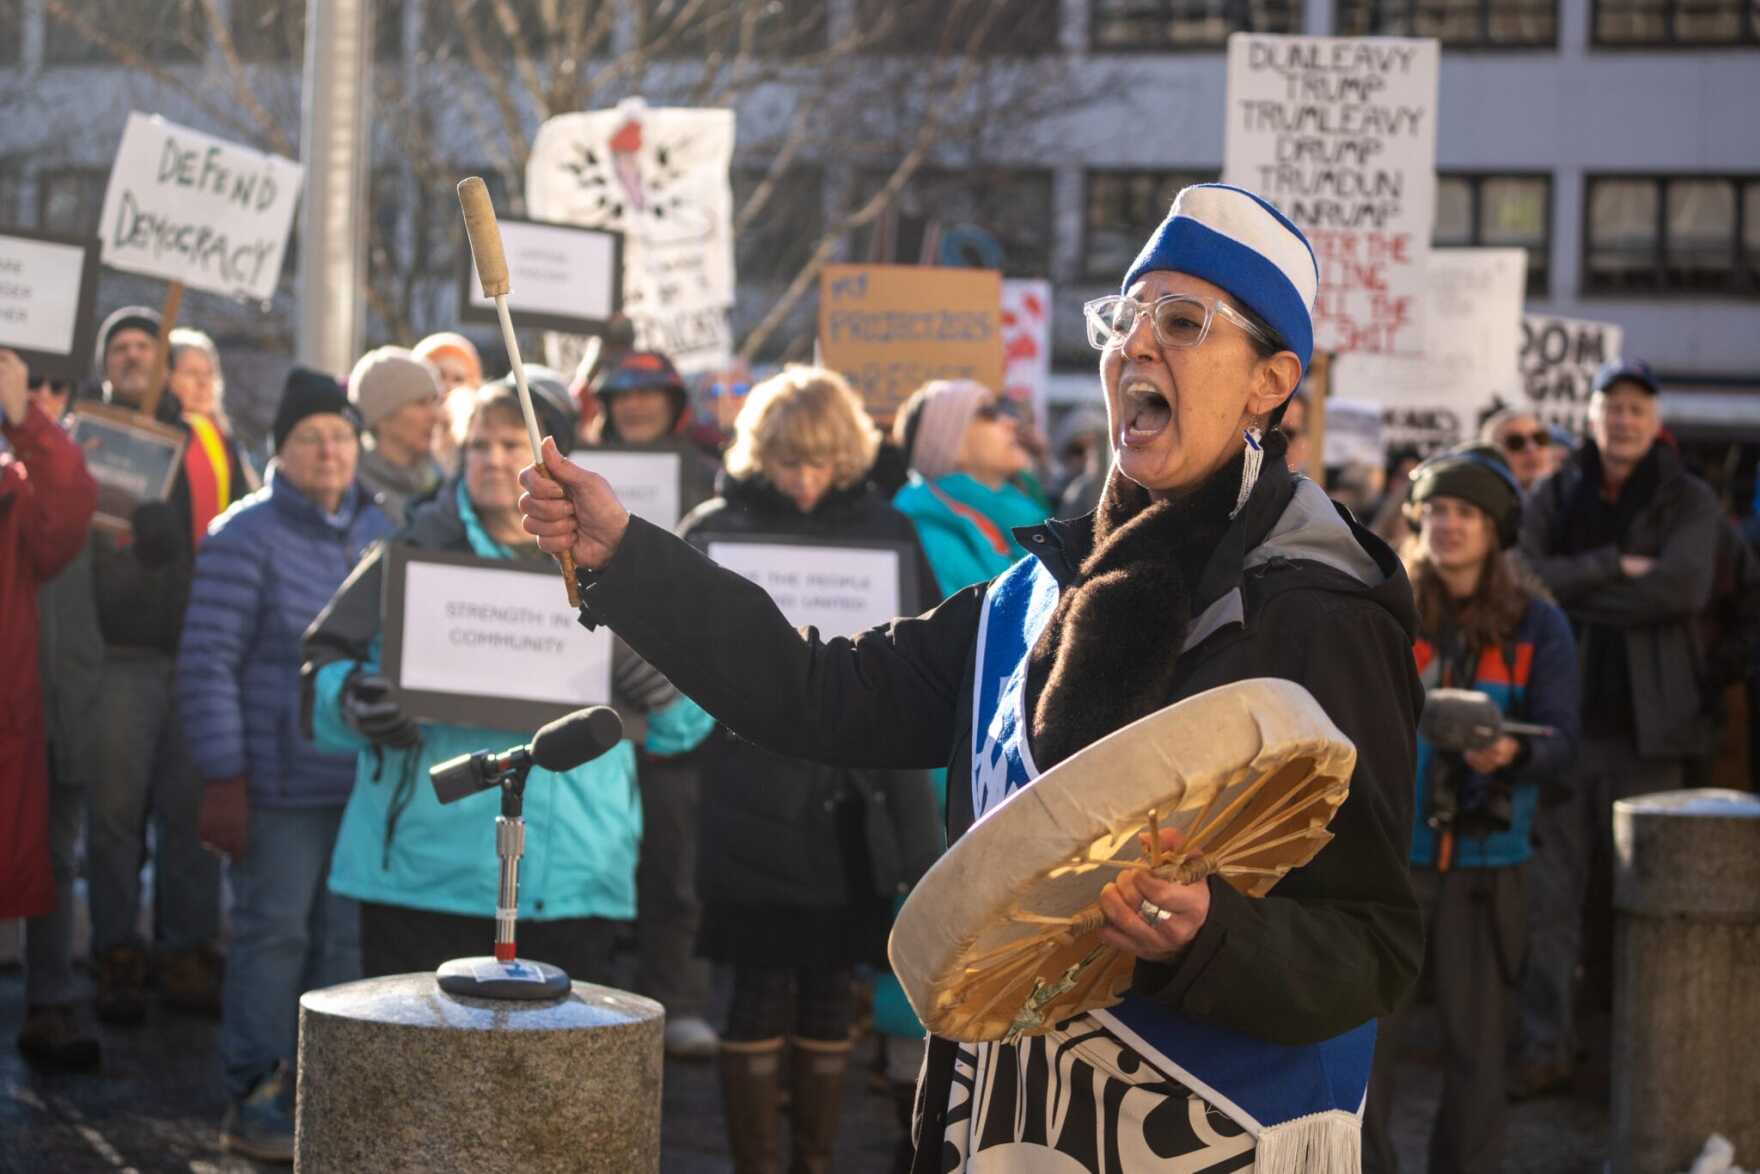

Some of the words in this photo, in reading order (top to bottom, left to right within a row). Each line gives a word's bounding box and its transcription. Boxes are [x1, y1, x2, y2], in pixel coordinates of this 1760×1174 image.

[1249, 41, 1415, 73] DUNLEAVY
[1285, 73, 1386, 102] TRUMP
[1239, 101, 1427, 135] TRUMLEAVY
[1275, 135, 1383, 165] DRUMP
[156, 137, 278, 215] DEFEND
[1284, 200, 1401, 230] NRUMP
[113, 187, 276, 289] DEMOCRACY
[1367, 231, 1410, 263] THE
[445, 600, 544, 626] STRENGTH
[549, 613, 572, 629] IN
[448, 627, 566, 655] COMMUNITY
